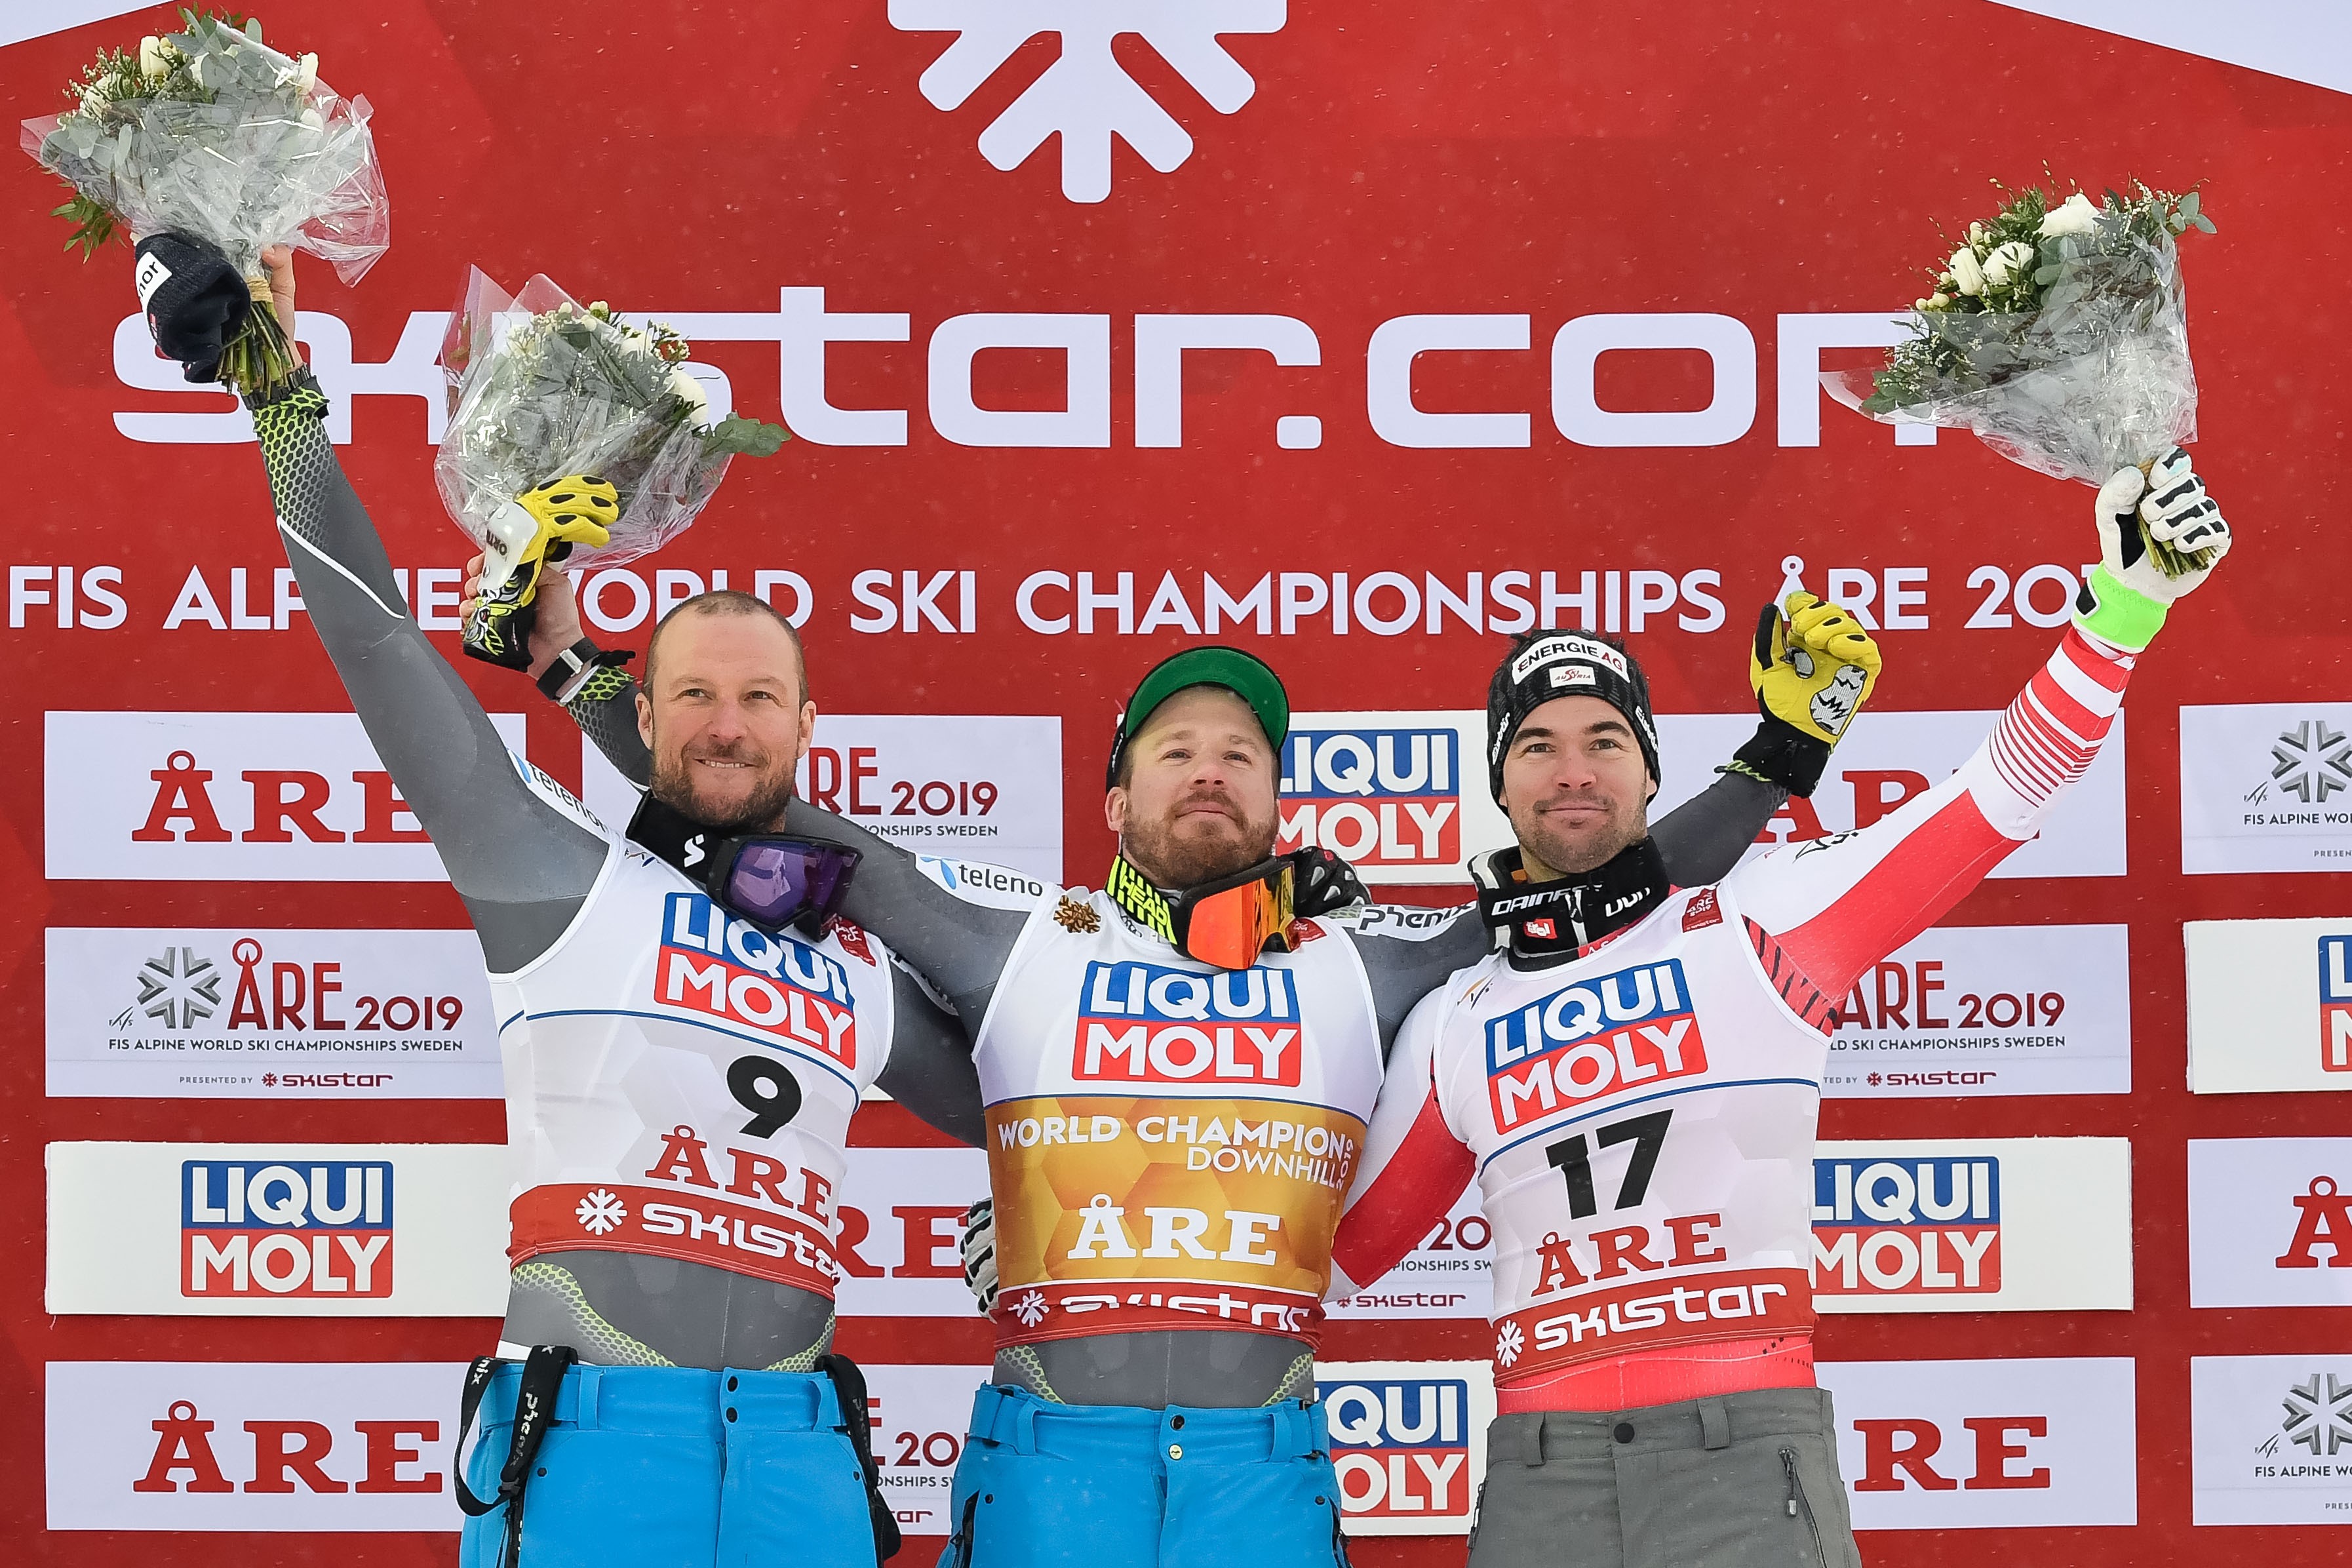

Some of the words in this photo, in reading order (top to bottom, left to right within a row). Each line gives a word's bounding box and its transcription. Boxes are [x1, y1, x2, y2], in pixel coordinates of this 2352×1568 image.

[9, 566, 127, 630] FIS
[163, 564, 462, 631] ALPE
[850, 569, 975, 634] SKI
[1015, 569, 1725, 637] CHAMPIONSHIPS
[1518, 642, 1599, 673] ENERGIE
[1601, 652, 1622, 671] AG
[808, 747, 881, 815] RE
[890, 781, 998, 816] 2019
[1280, 734, 1449, 796] IQUI
[936, 825, 998, 836] SWEDEN
[1280, 802, 1457, 861] MOLY
[2244, 814, 2264, 825] FIS
[2269, 813, 2320, 825] ALPINE
[2324, 813, 2352, 824] WO
[958, 863, 1043, 897] teleno
[1120, 875, 1167, 926] HEAD
[673, 897, 848, 1005] LIQUI
[227, 938, 346, 1032] ÅRE
[354, 996, 463, 1031] 2019
[667, 952, 853, 1057] MOLY
[1090, 966, 1289, 1021] LIQUI
[1957, 992, 2066, 1029] 2019
[109, 1039, 130, 1050] FIS
[134, 1039, 186, 1050] ALPINE
[190, 1039, 243, 1051] WORLD
[248, 1040, 269, 1051] SKI
[274, 1040, 397, 1051] CHAMPIONSHIPS
[401, 1040, 463, 1051] SWEDEN
[1494, 964, 1681, 1069] LIQUI
[1852, 1040, 1873, 1050] SKI
[1879, 1037, 2000, 1050] CHAMPIONSHIPS
[2004, 1036, 2065, 1048] SWEDEN
[283, 1072, 393, 1087] skistar
[1084, 1023, 1299, 1080] MOLY
[1497, 1019, 1693, 1127] MOLY
[1887, 1070, 1997, 1086] skistar
[726, 1055, 802, 1139] 9
[998, 1116, 1121, 1152] WORLD
[1137, 1116, 1346, 1162] CHAMPION
[1187, 1147, 1335, 1189] DOWNHILL
[1336, 1139, 1354, 1192] 2019
[1545, 1108, 1674, 1220] 17
[192, 1166, 383, 1228] LIQUI
[645, 1124, 832, 1230] ÅRE
[1067, 1194, 1281, 1266] ÅRE
[1531, 1213, 1727, 1297] ÅRE
[191, 1234, 391, 1293] MOLY
[1811, 1230, 1998, 1291] MOLY
[1356, 1293, 1466, 1308] skistar
[1534, 1283, 1788, 1351] skistar
[132, 1399, 443, 1493] ÅRE
[1314, 1384, 1458, 1448] QUI
[1333, 1453, 1466, 1513] OLY
[1853, 1416, 2051, 1491] RE
[2255, 1466, 2276, 1478] FIS
[2280, 1466, 2330, 1477] ALPINE
[2336, 1465, 2352, 1476] W
